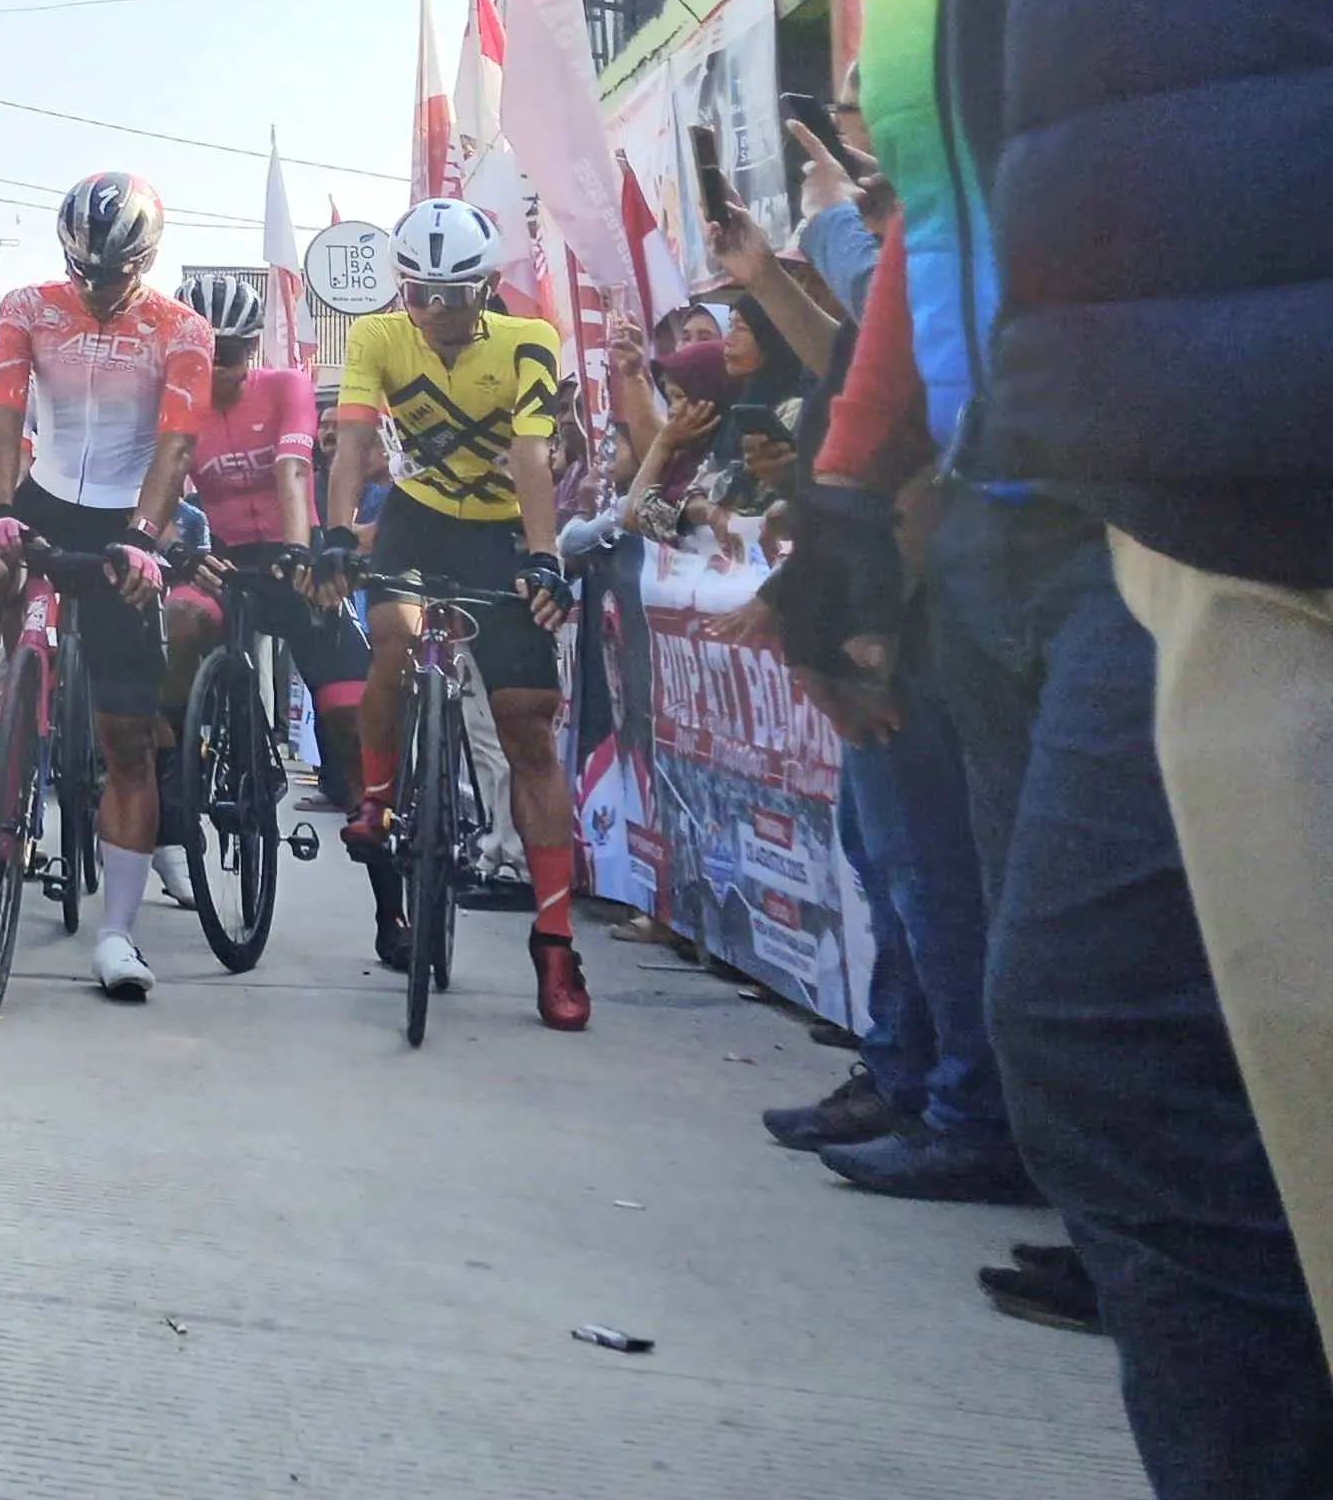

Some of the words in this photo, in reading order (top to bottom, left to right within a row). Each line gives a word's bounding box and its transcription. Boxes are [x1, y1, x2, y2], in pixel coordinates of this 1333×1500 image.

[350, 245, 375, 259] BO
[350, 260, 374, 273] BA
[351, 275, 377, 289] HO
